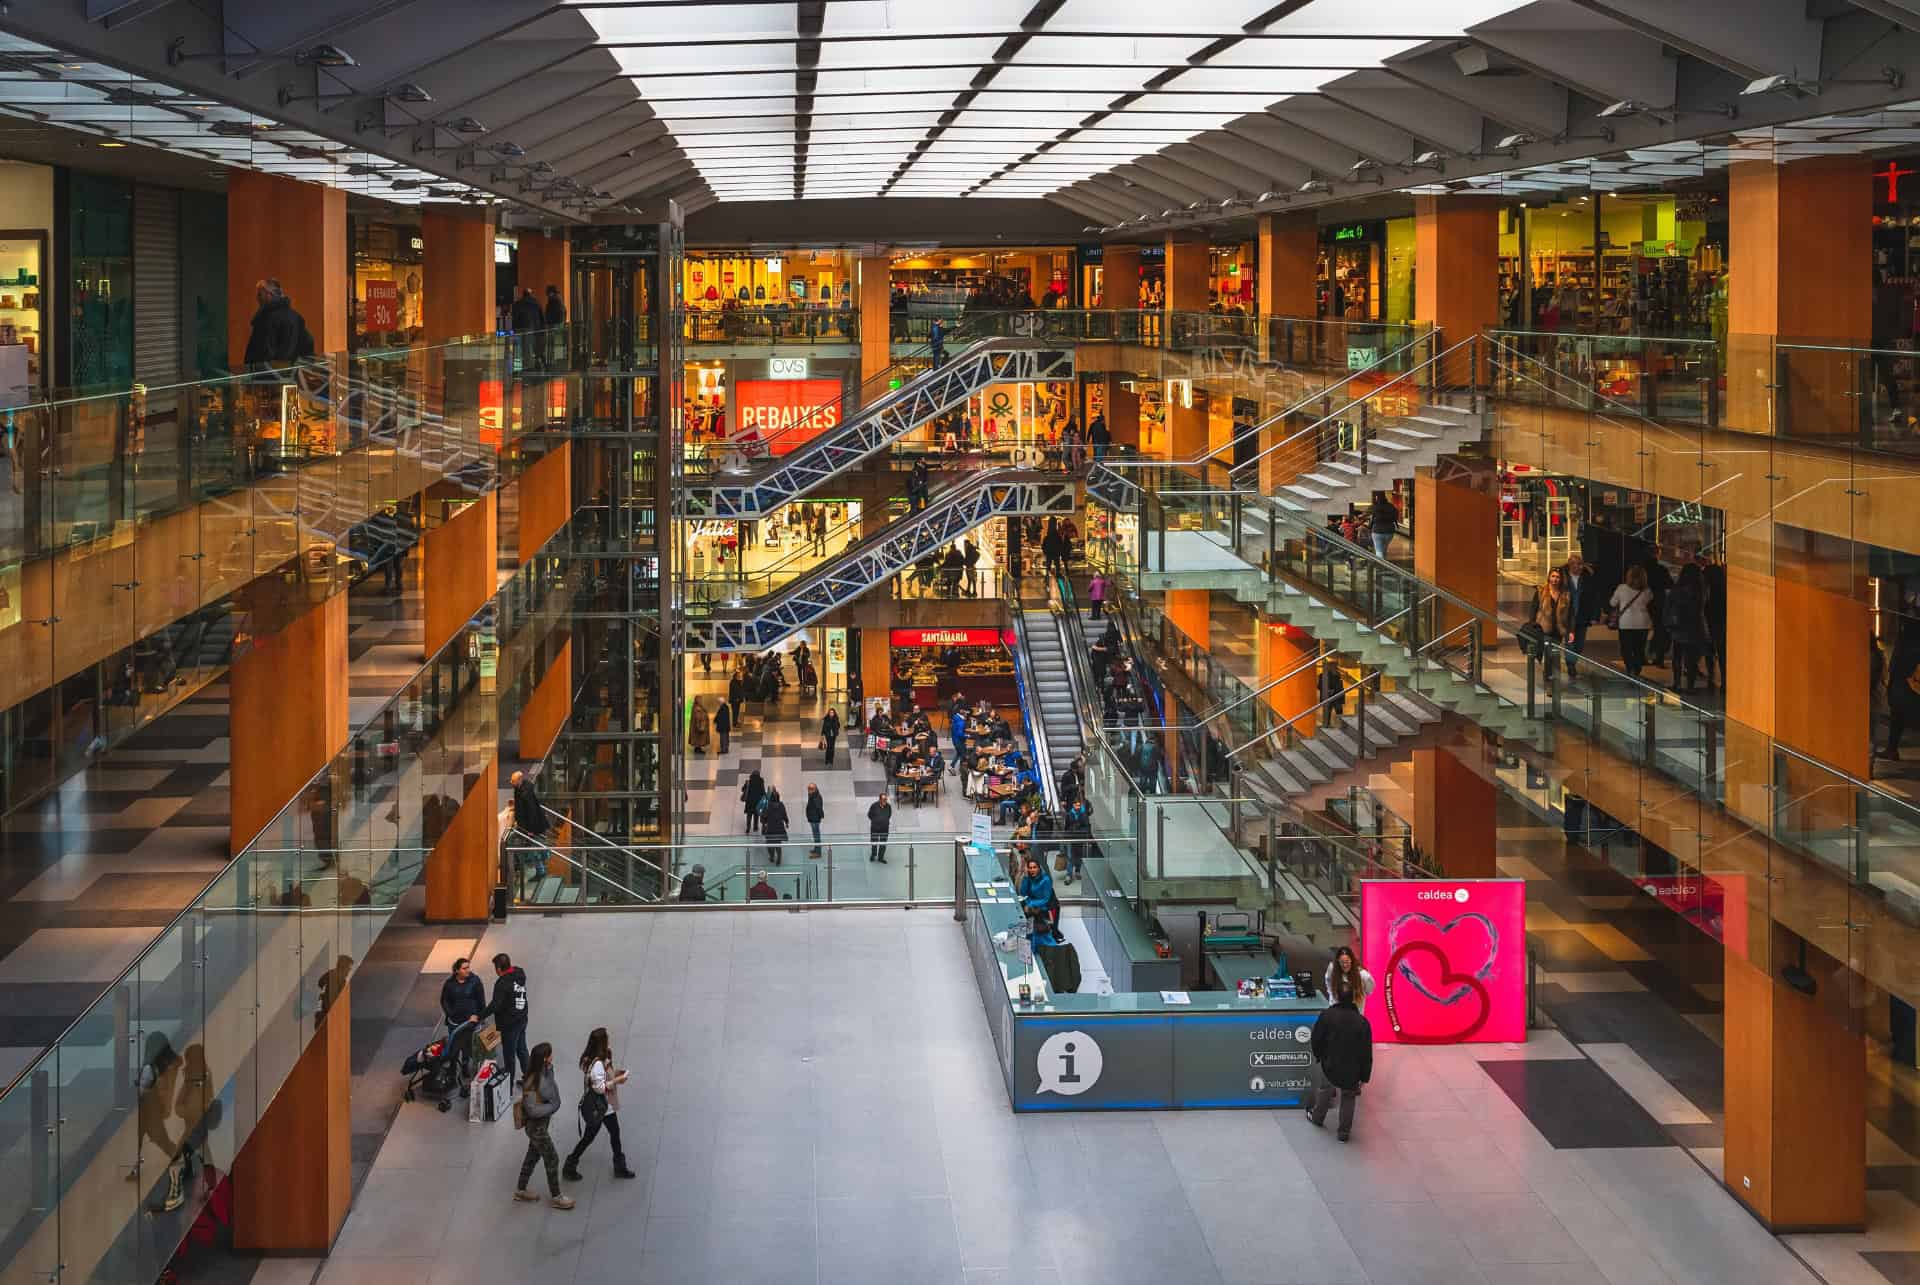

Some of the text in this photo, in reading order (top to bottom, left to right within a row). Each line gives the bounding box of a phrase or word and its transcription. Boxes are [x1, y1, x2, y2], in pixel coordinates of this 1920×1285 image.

[772, 360, 804, 373] OVS
[743, 406, 836, 429] REBAIXES
[1417, 890, 1453, 900] caldea
[1249, 1027, 1292, 1040] caldea
